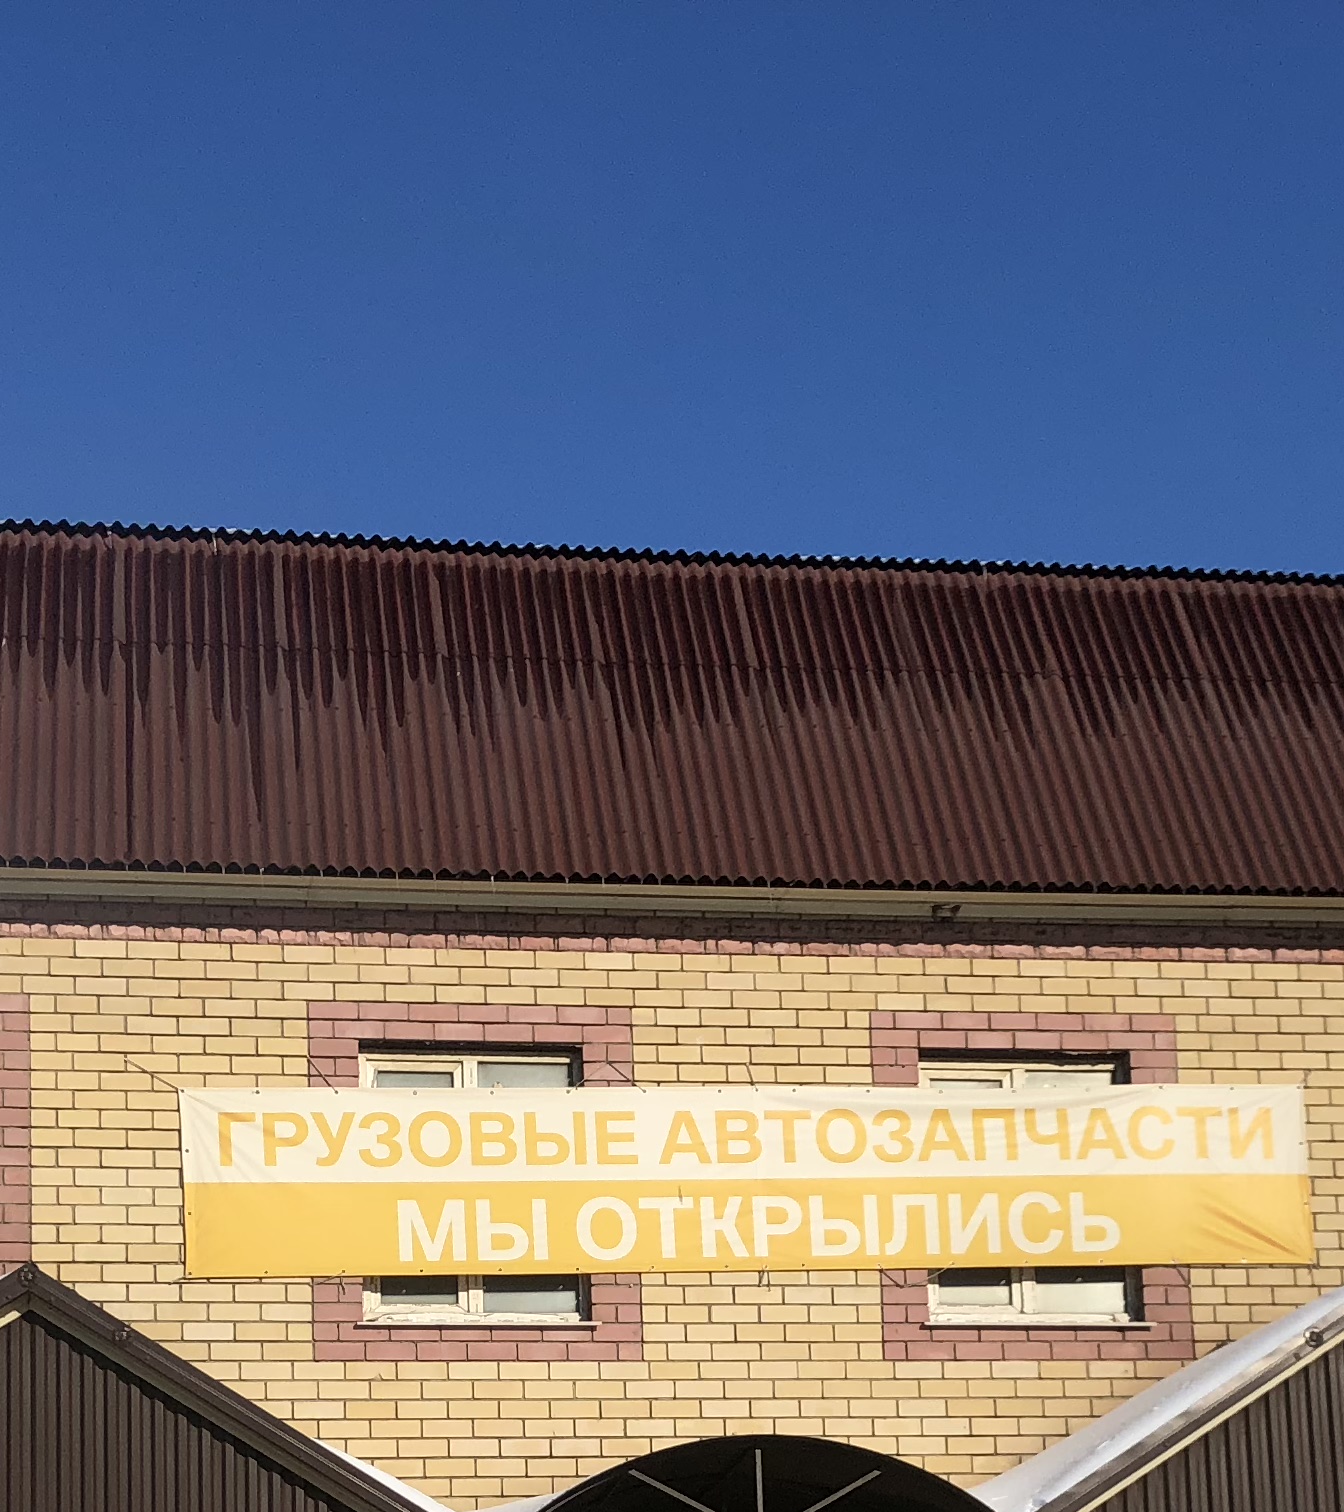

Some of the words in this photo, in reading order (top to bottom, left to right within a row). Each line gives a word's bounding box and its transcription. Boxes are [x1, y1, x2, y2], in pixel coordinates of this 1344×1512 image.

[216, 1110, 640, 1168] ГРУЗОВЫЕ
[658, 1105, 1276, 1166] АВТОЗАПЧАСТИ
[396, 1198, 550, 1263] МЫ
[574, 1190, 1122, 1262] ОТКРЫЛИСЬ
